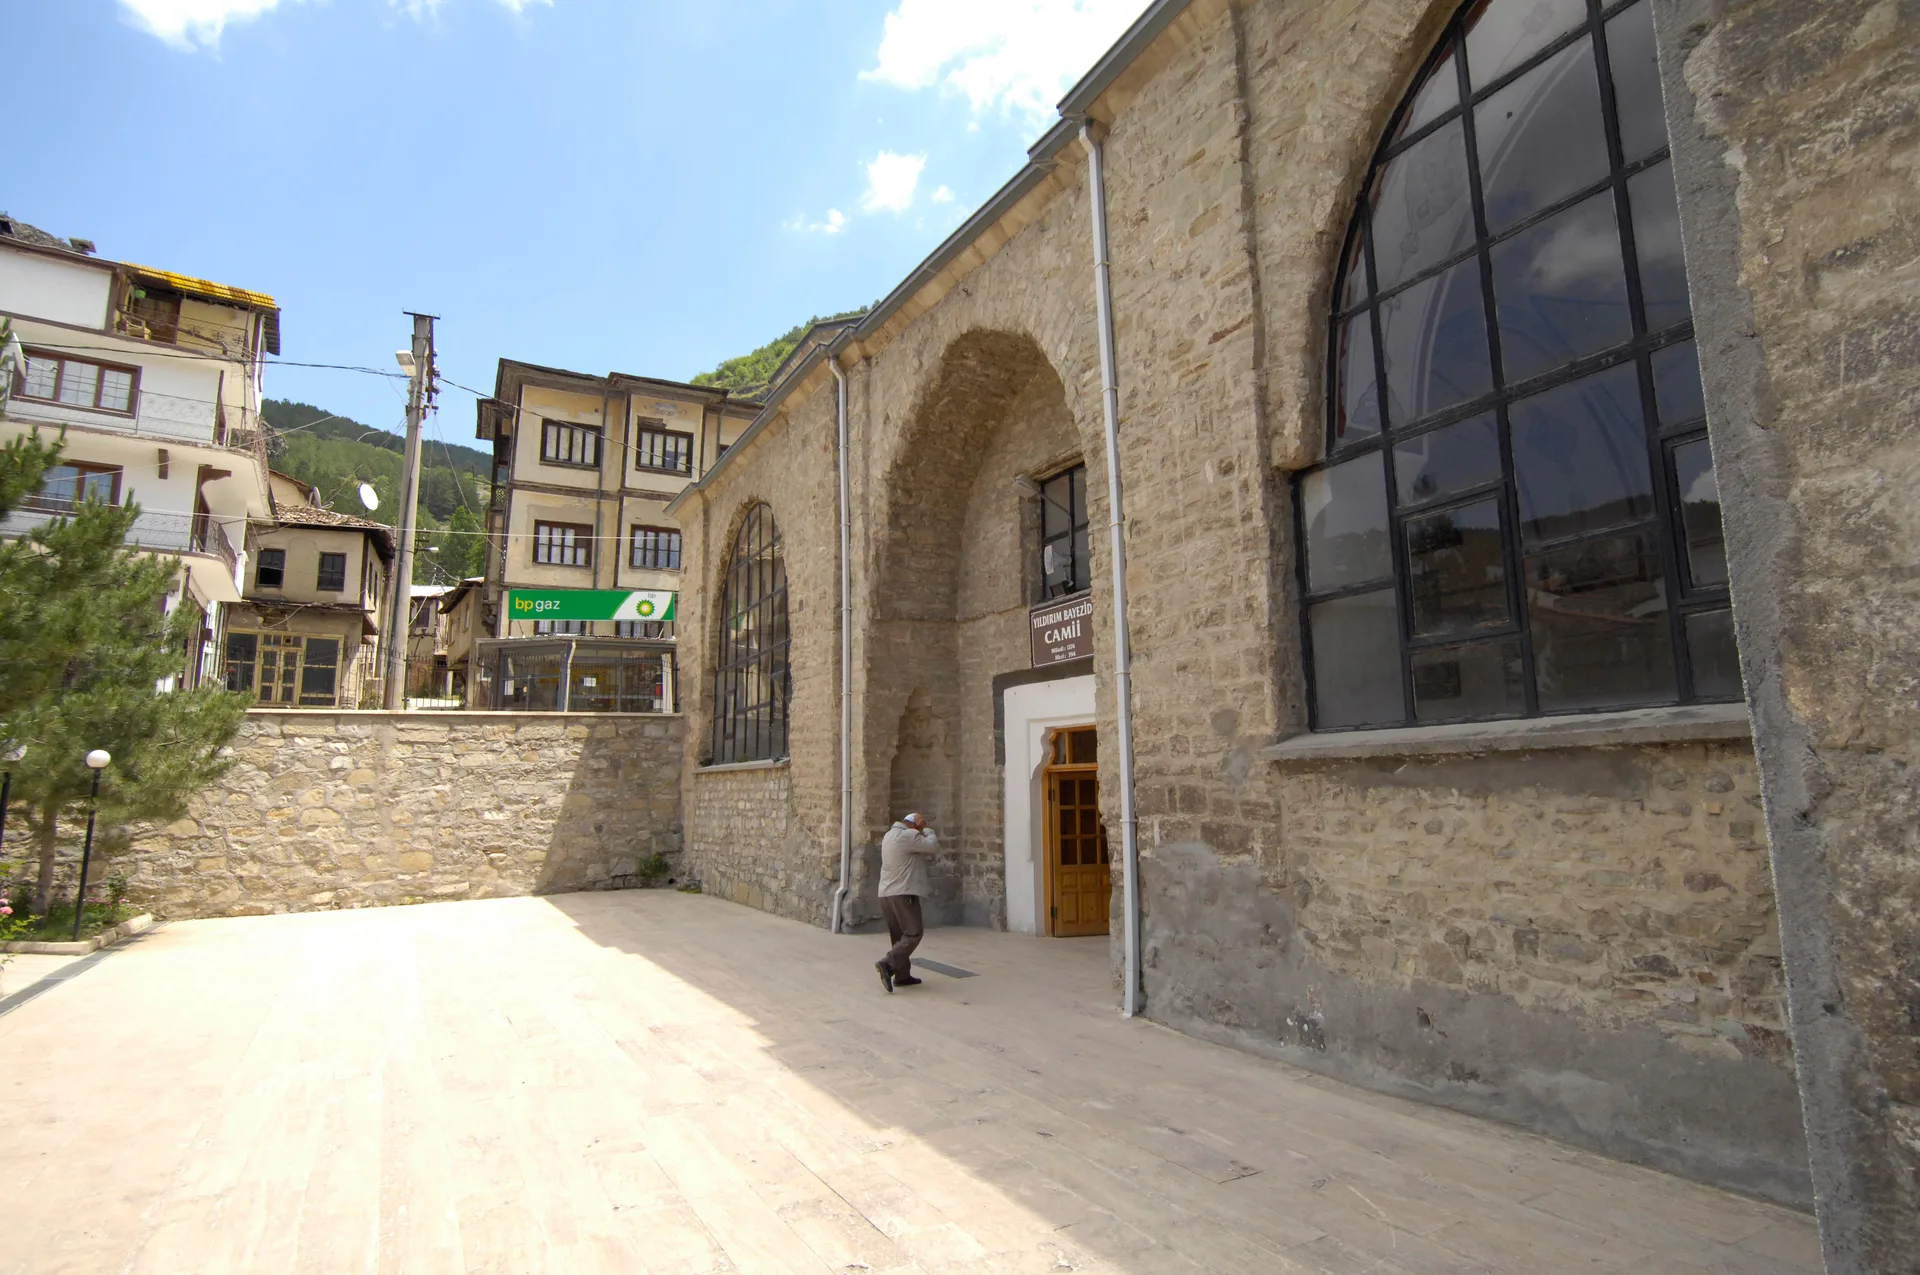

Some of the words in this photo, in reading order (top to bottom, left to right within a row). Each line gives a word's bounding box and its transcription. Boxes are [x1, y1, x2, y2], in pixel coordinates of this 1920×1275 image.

[515, 596, 534, 612] bp
[535, 600, 561, 612] gaz
[1033, 611, 1062, 628] YILDIRIM
[1063, 601, 1092, 620] BAYEZİD
[1044, 620, 1080, 643] CAMİİ
